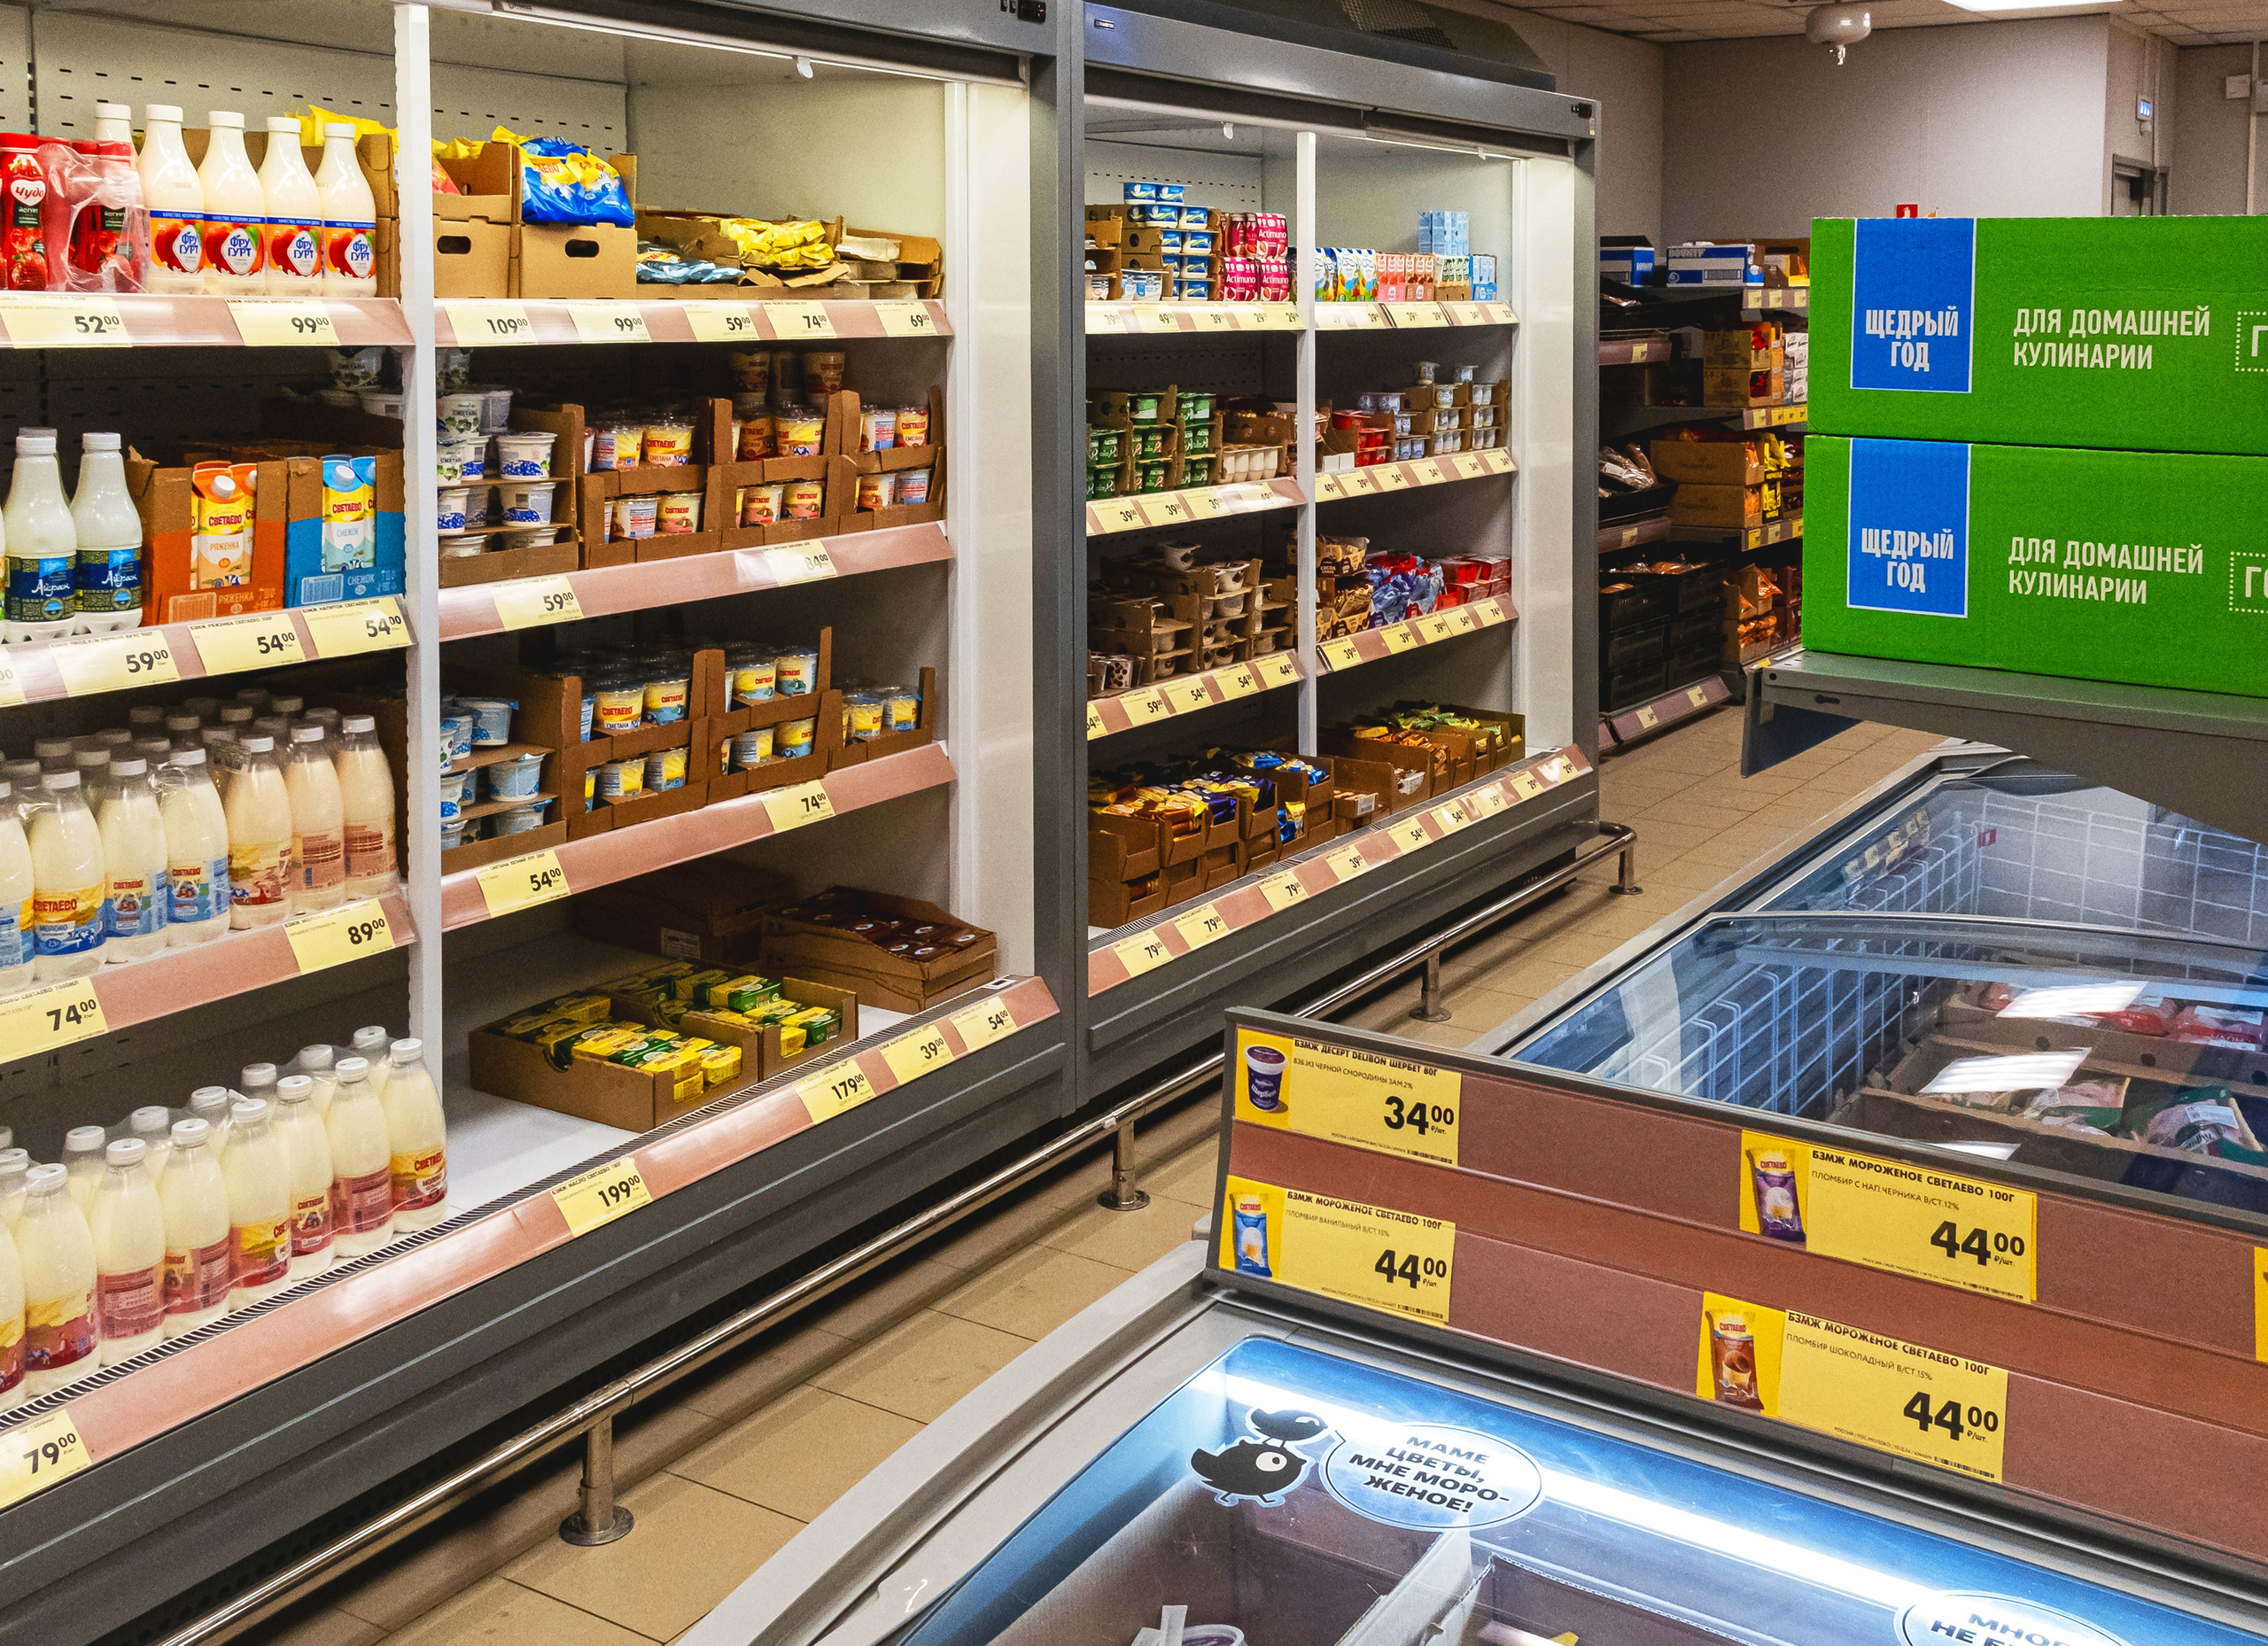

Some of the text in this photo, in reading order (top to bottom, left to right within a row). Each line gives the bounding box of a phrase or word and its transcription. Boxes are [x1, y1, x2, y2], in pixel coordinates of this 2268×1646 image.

[15, 186, 44, 198] Чудо
[1258, 229, 1286, 238] Actimuno
[1226, 275, 1256, 283] Actimuno
[1262, 275, 1288, 283] Actimuno
[1865, 305, 1960, 337] ЩЕДРЫЙ
[2013, 305, 2210, 338] ДЛЯ ДОМАШНЕЙ
[1890, 341, 1930, 372] ГОД
[2013, 342, 2153, 370] КУЛИНАРИИ
[647, 439, 676, 448] СВЕТАЕВО
[209, 514, 243, 526] СВЕТАЕВО
[332, 501, 361, 514] СВЕТАЕВО
[209, 540, 239, 551] РЯЖЕНКА
[1860, 528, 1954, 560] ЩЕДРЫЙ
[2008, 537, 2204, 575] ДЛЯ ДОМАШНЕЙ
[1887, 562, 1926, 594] ГОД
[2008, 571, 2148, 604] КУЛИНАРИИ
[218, 592, 254, 604] РЯЖЕНКА
[602, 707, 633, 716] СВЕТАЕВО
[34, 899, 78, 912] СВЕТАЕВО
[1294, 1039, 1438, 1076] БЗМЖ ДЕСЕРТ DELIBON ШЕРБЕТ 80Г
[1315, 1062, 1341, 1074] ЧЕРНОЙ
[1343, 1068, 1387, 1083] СМОРОДИНЫ
[1812, 1170, 1852, 1187] ПЛОМБИР
[1813, 1150, 2015, 1202] БЗМЖ МОРОЖЕНОЕ СВЕТАЕВО 100Г
[1285, 1209, 1318, 1222] ПЛОМБИР
[1319, 1217, 1361, 1232] ВАНИЛЬНЫЙ
[1287, 1191, 1441, 1230] БЗМЖ МОРОЖЕНОЕ СВЕТАЕВО 100Г
[1786, 1333, 1828, 1350] ПЛОМБИР
[1829, 1345, 1895, 1370] ШОКОЛАДНЫЙ
[1788, 1312, 1990, 1376] БЗМЖ МОРОЖЕНОЕ СВЕТАЕВО 100Г
[1405, 1436, 1490, 1465] МАМЕ
[1348, 1454, 1511, 1502] МНЕ МОРО-
[1386, 1447, 1485, 1483] ЦВЕТЫ,
[1363, 1475, 1473, 1513] ЖЕНОЕ!
[1930, 1620, 1977, 1644] НЕ
